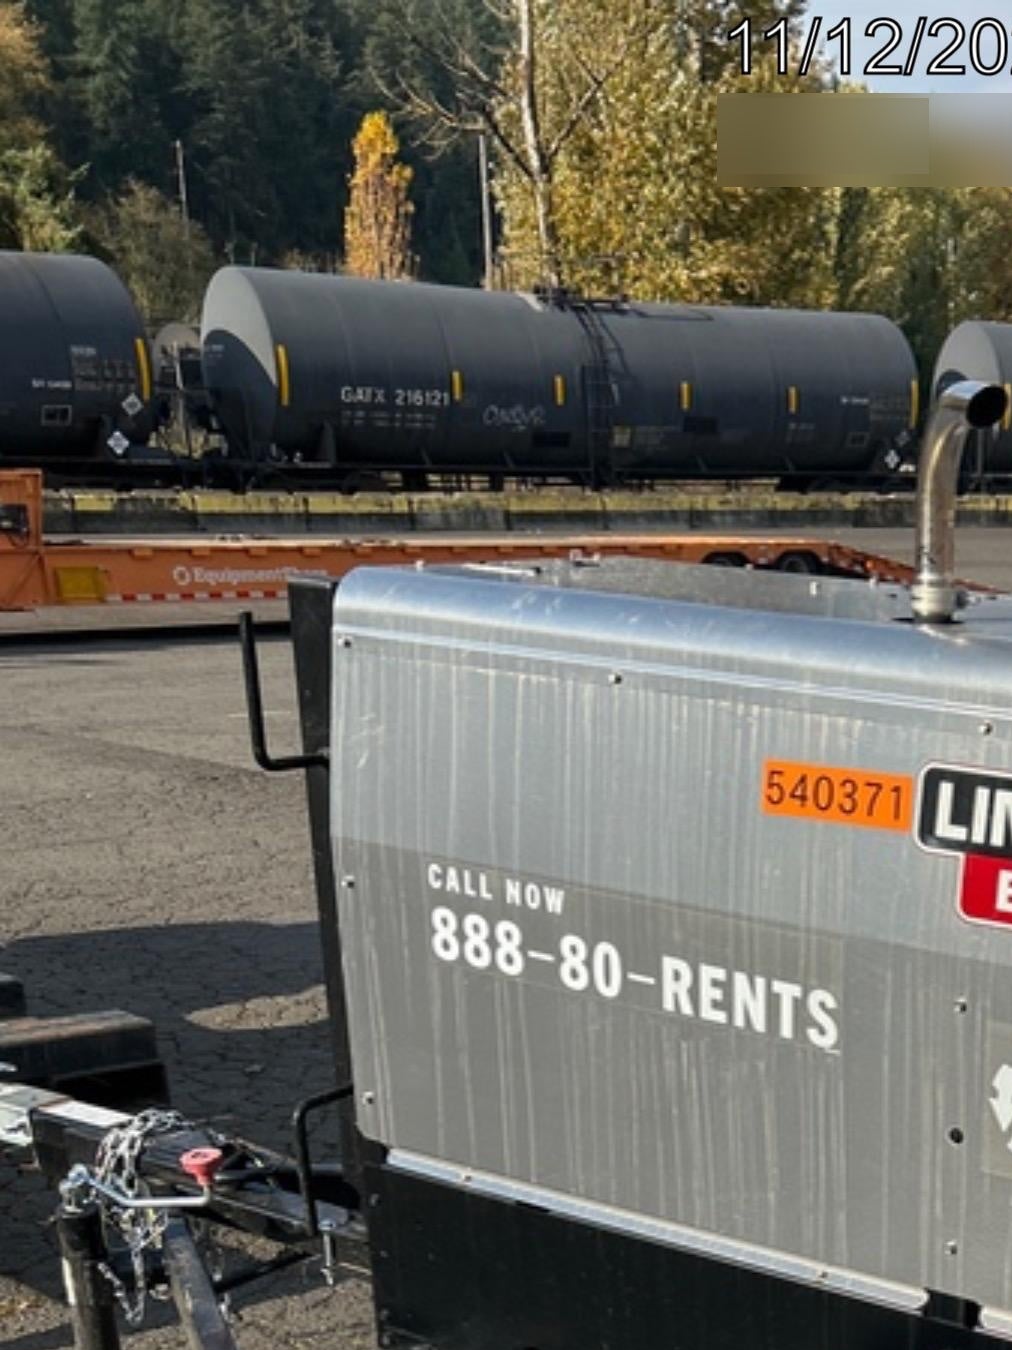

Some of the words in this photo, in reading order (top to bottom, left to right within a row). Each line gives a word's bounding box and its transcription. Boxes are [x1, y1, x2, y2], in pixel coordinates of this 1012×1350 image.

[765, 769, 903, 821] 540371
[427, 862, 494, 901] CALL
[505, 877, 566, 915] NOW
[430, 905, 839, 1050] 888-80-RENTS
